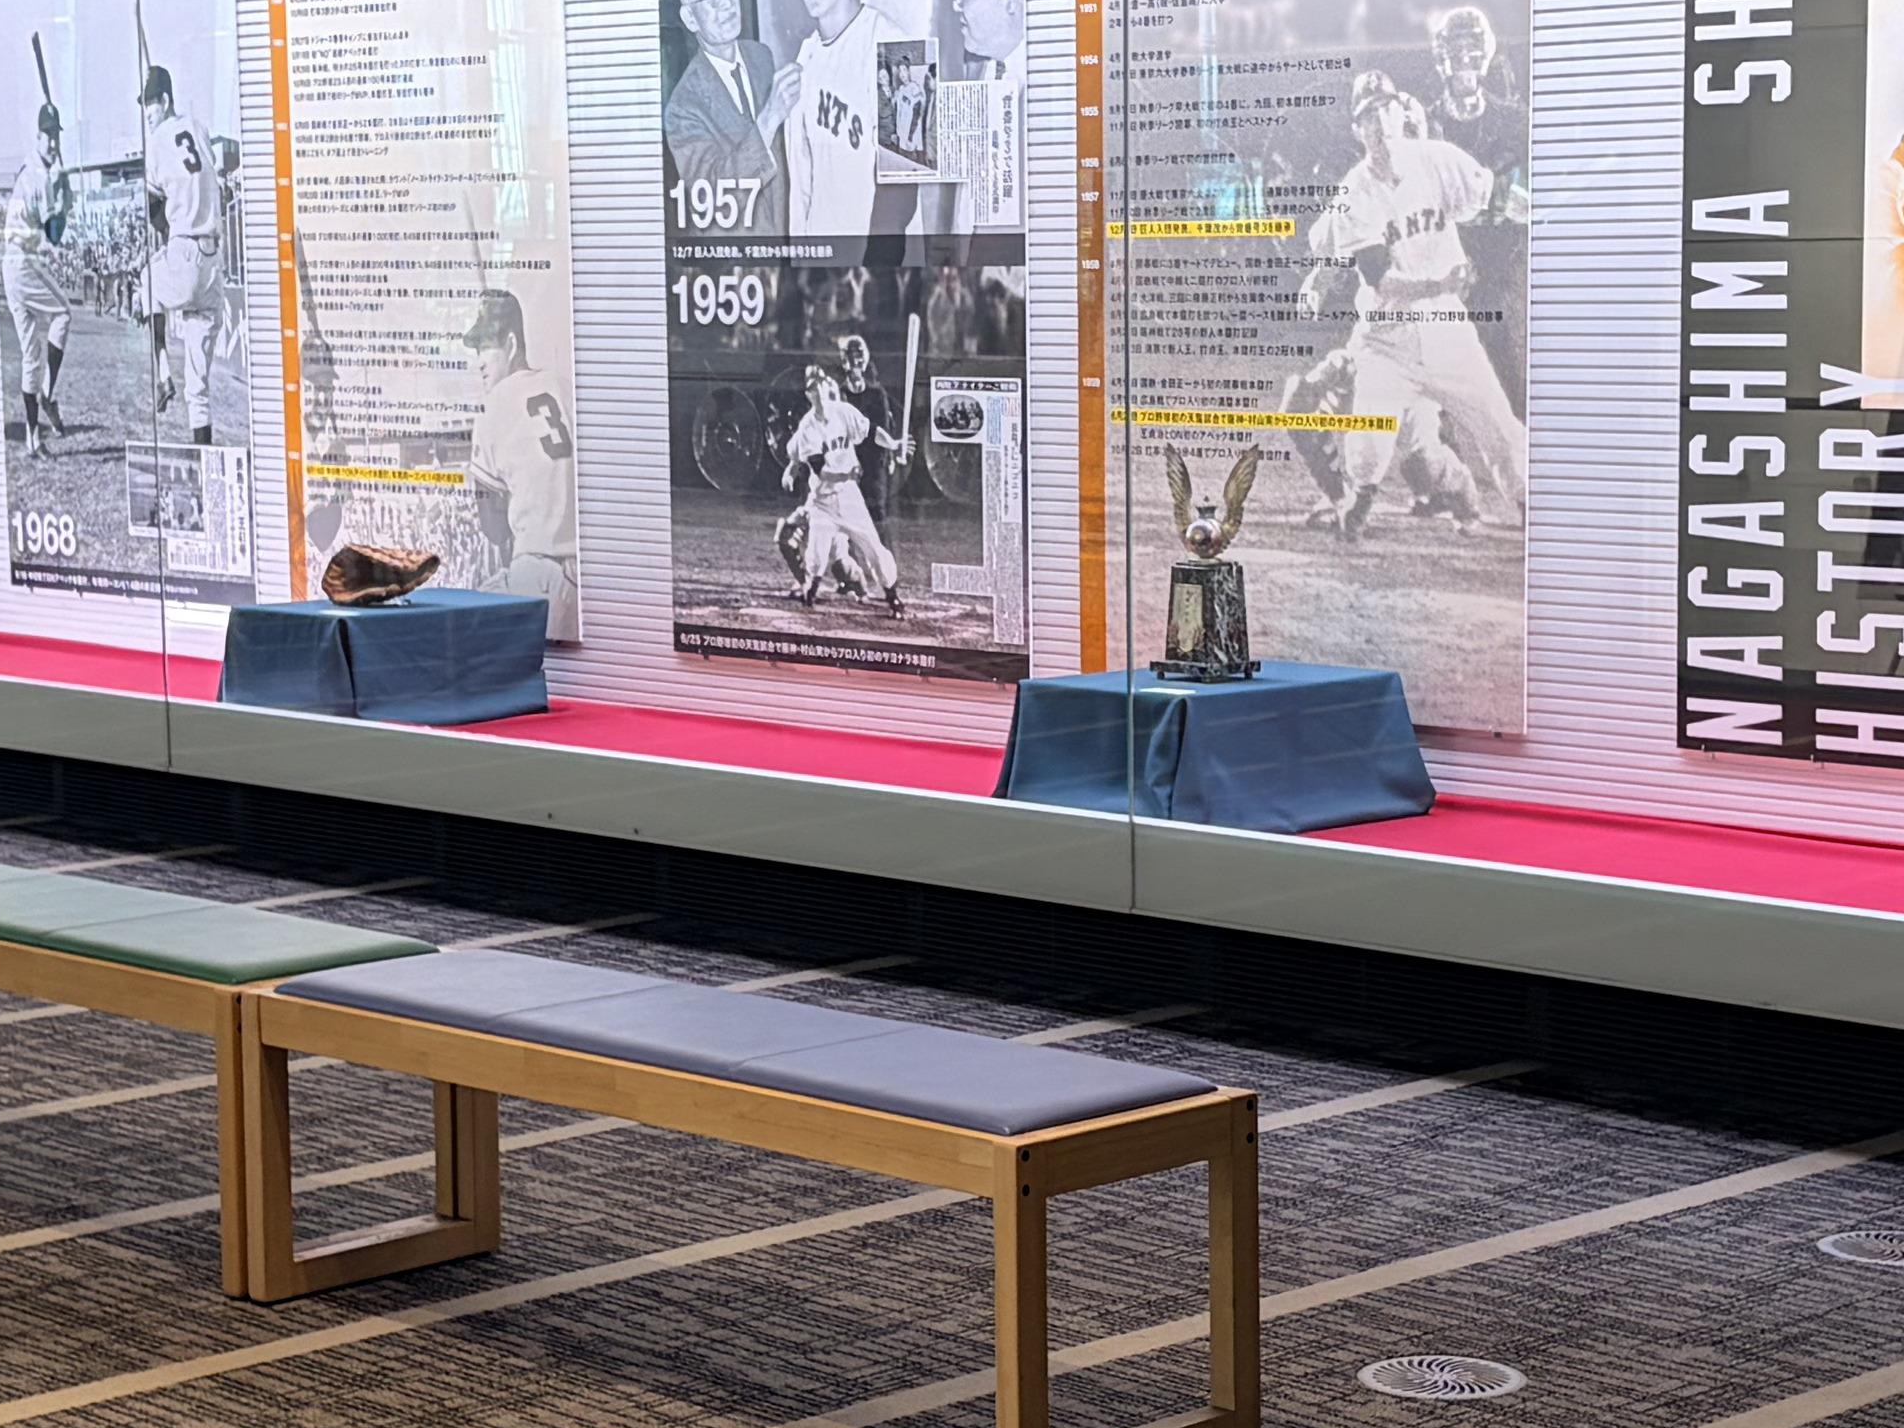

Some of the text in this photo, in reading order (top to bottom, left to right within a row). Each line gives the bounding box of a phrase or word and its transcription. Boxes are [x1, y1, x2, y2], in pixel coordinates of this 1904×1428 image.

[175, 130, 202, 175] 3
[669, 178, 762, 230] 1957
[672, 274, 765, 325] 1959
[526, 392, 573, 461] 3
[1686, 188, 1791, 748] NAGASHIMA
[12, 511, 77, 557] 1968
